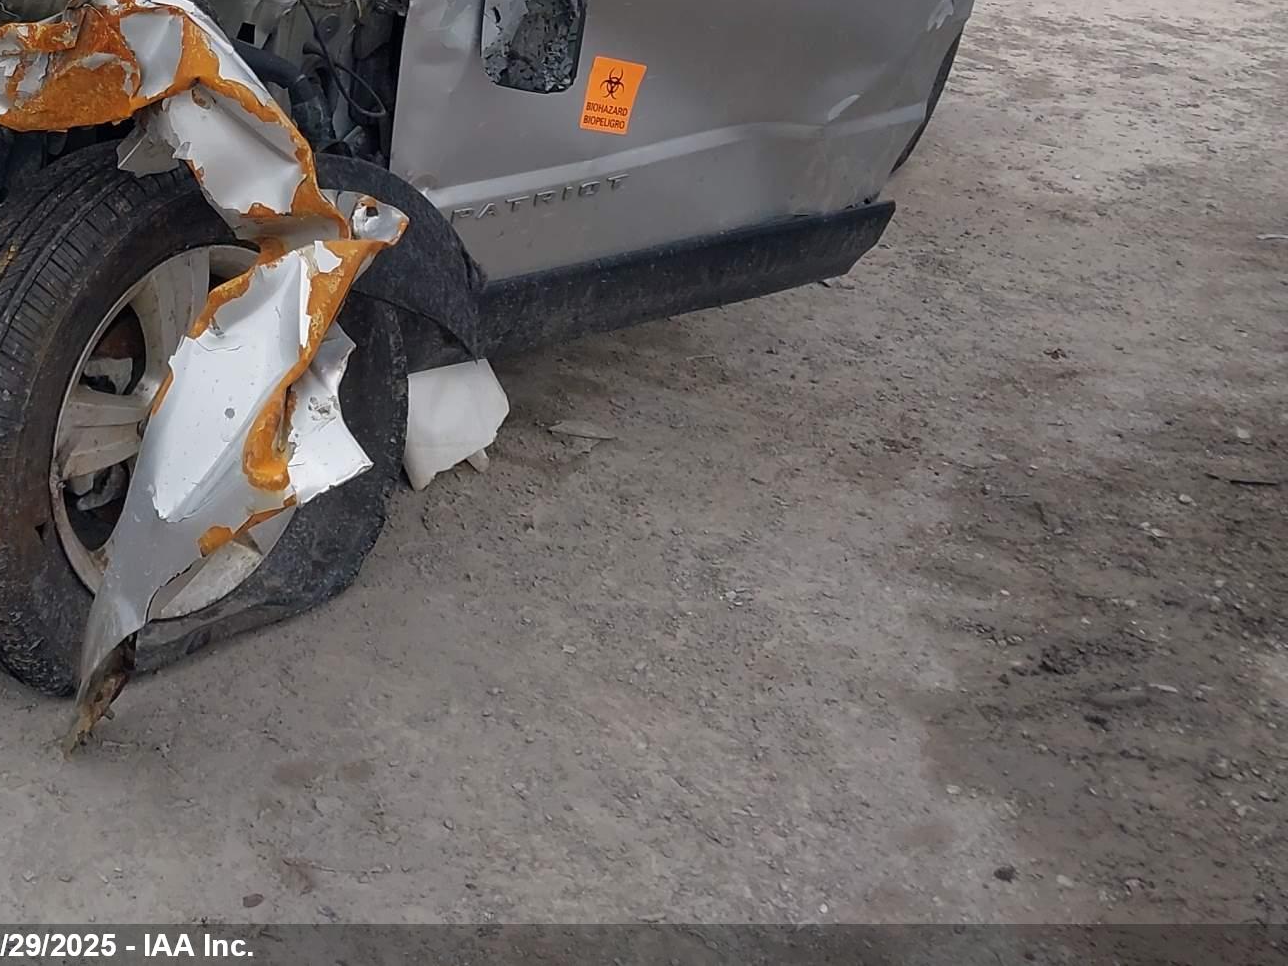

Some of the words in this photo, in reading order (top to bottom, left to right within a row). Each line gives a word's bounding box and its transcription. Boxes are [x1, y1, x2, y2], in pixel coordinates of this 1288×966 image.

[585, 101, 628, 117] BIOHAZARD
[582, 114, 626, 130] BIOPELIGRO
[450, 173, 631, 224] PATRIOT
